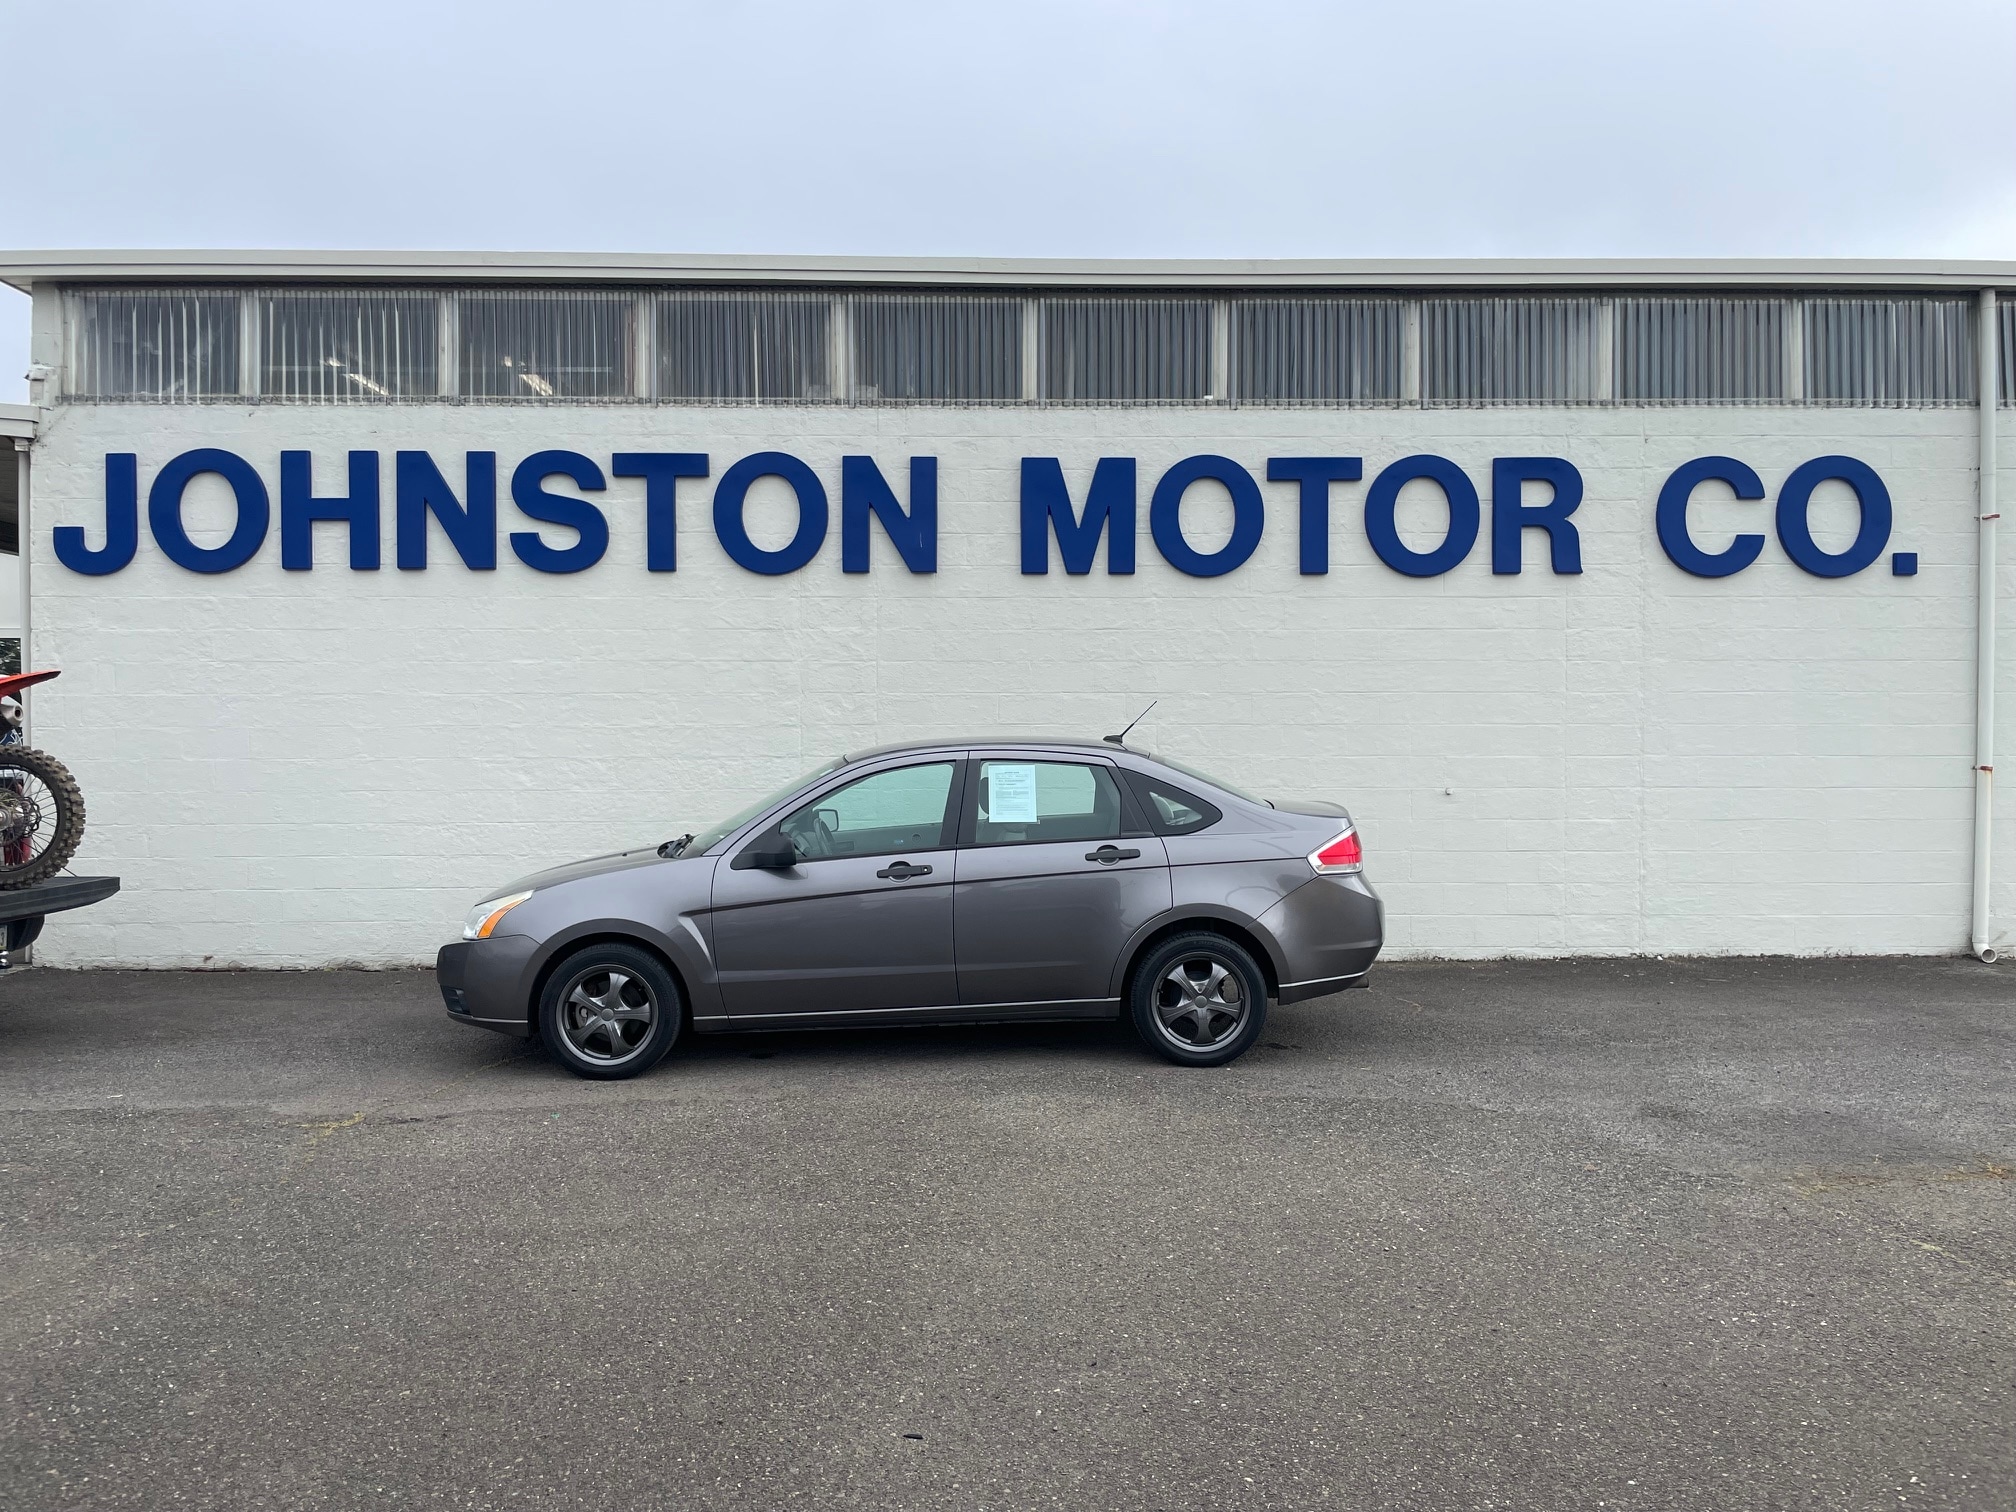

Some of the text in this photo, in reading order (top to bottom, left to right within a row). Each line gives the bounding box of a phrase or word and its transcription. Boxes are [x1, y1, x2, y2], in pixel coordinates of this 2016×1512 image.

[53, 448, 1918, 578] JOHNSTON MOTOR CO.
